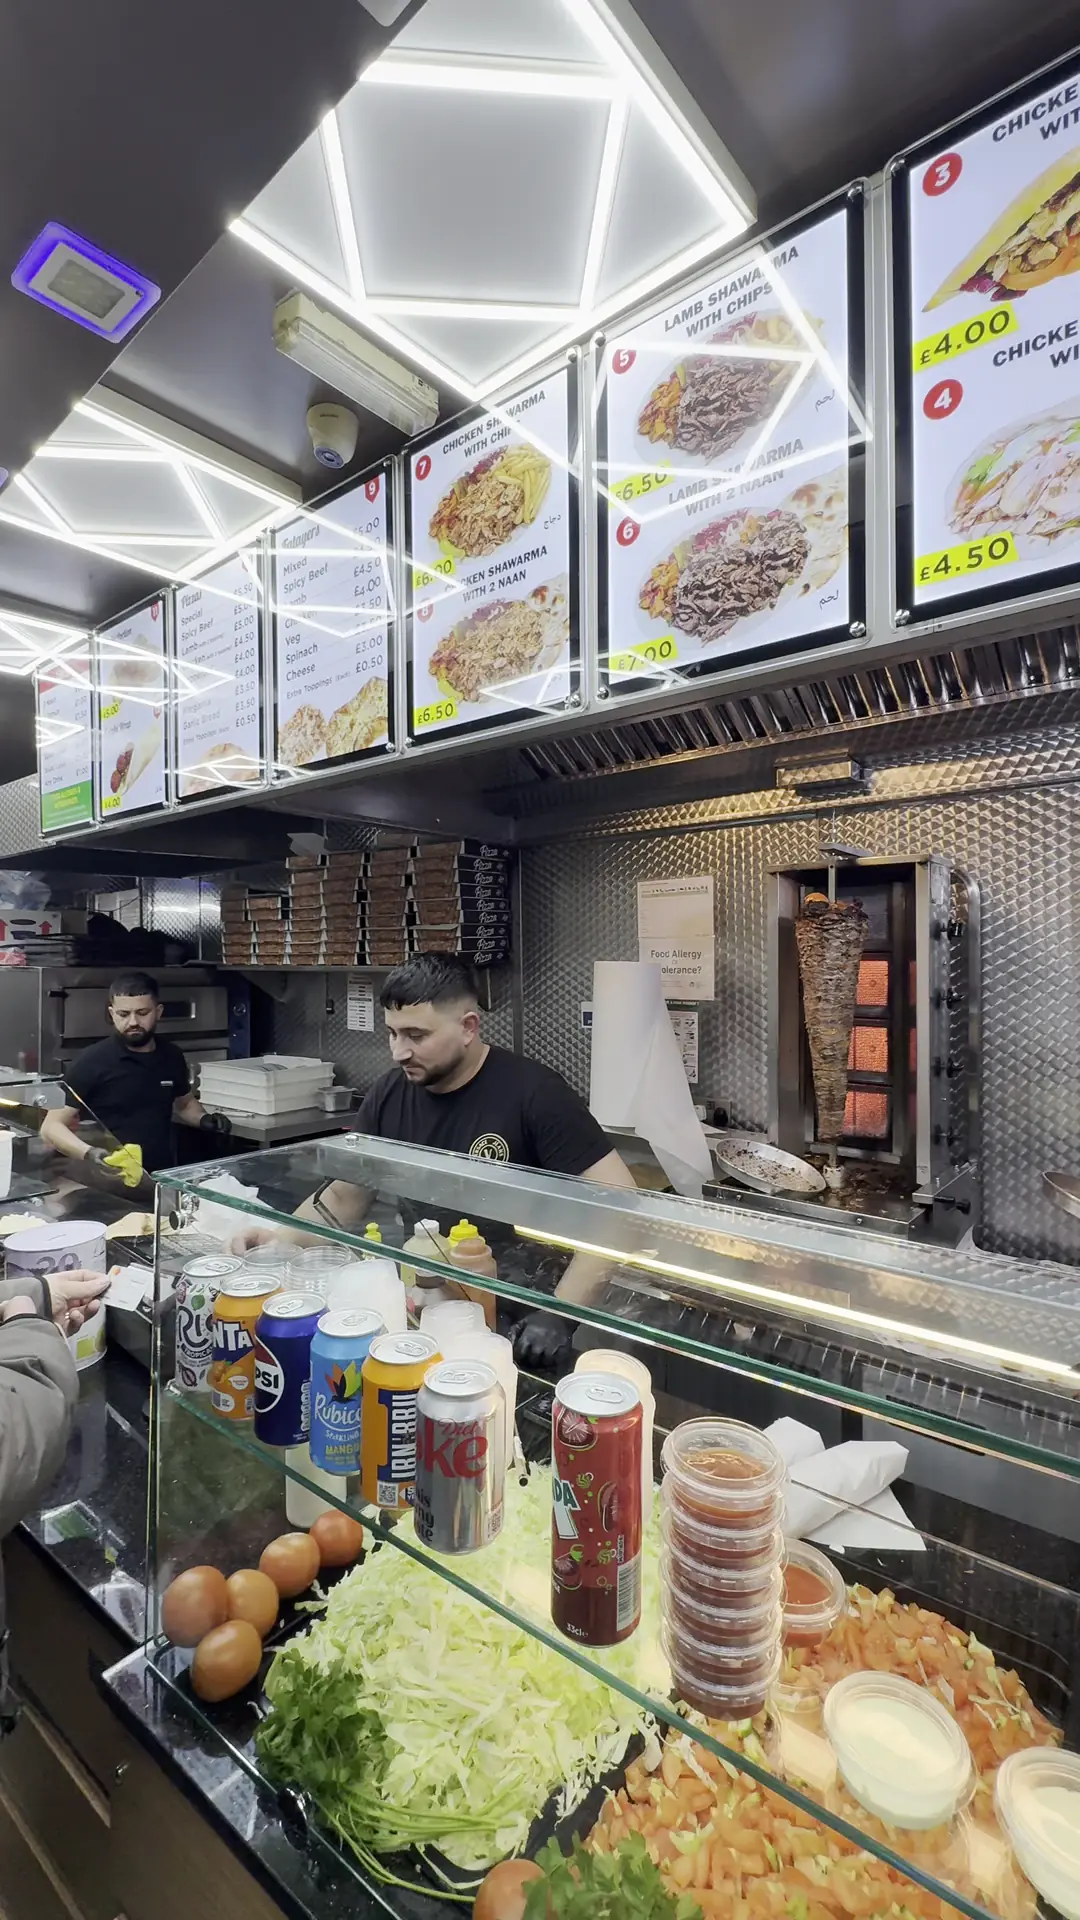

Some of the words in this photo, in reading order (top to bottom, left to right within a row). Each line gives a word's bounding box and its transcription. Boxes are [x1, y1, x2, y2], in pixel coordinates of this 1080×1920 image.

[992, 84, 1079, 143] CHICKE
[934, 160, 951, 188] 3
[664, 302, 704, 332] LAMB
[707, 246, 799, 307] SHAWAMA
[685, 307, 722, 338] WITH
[726, 281, 773, 316] CHIPS
[919, 310, 1010, 365] £4.00
[992, 319, 1080, 367] CHICKE
[619, 349, 629, 366] 5
[933, 387, 952, 410] 4
[442, 423, 484, 455] CHICKEN
[486, 389, 546, 431] SHWARMA
[463, 437, 488, 458] WITH
[490, 421, 519, 444] CHI
[419, 462, 428, 476] 7
[368, 482, 376, 496] 9
[668, 478, 709, 505] LAMB
[684, 492, 721, 517] WITH
[726, 487, 736, 500] 2
[739, 468, 785, 494] NAAN
[623, 524, 634, 540] 6
[283, 556, 308, 577] Mixed
[488, 545, 548, 577] SHAWARMA
[919, 537, 1010, 582] £4.50
[283, 577, 306, 594] Spicy
[308, 562, 328, 582] Beef
[286, 593, 307, 606] amb
[354, 556, 381, 578] £4.50
[354, 576, 382, 597] £4.00
[462, 585, 486, 603] WITH
[489, 581, 496, 593] 2
[497, 568, 527, 589] NAAN
[234, 614, 254, 631] £5.00
[285, 633, 301, 647] Veg
[286, 642, 318, 665] Spinach
[286, 663, 316, 682] Cheese
[355, 634, 383, 655] £3.00
[355, 654, 383, 674] £0.50
[416, 702, 454, 725] £6.50
[650, 949, 670, 958] Food
[671, 949, 702, 960] Allergy
[661, 965, 702, 975] olerance?
[184, 1346, 213, 1358] TROPICA
[325, 1444, 361, 1455] MANGO
